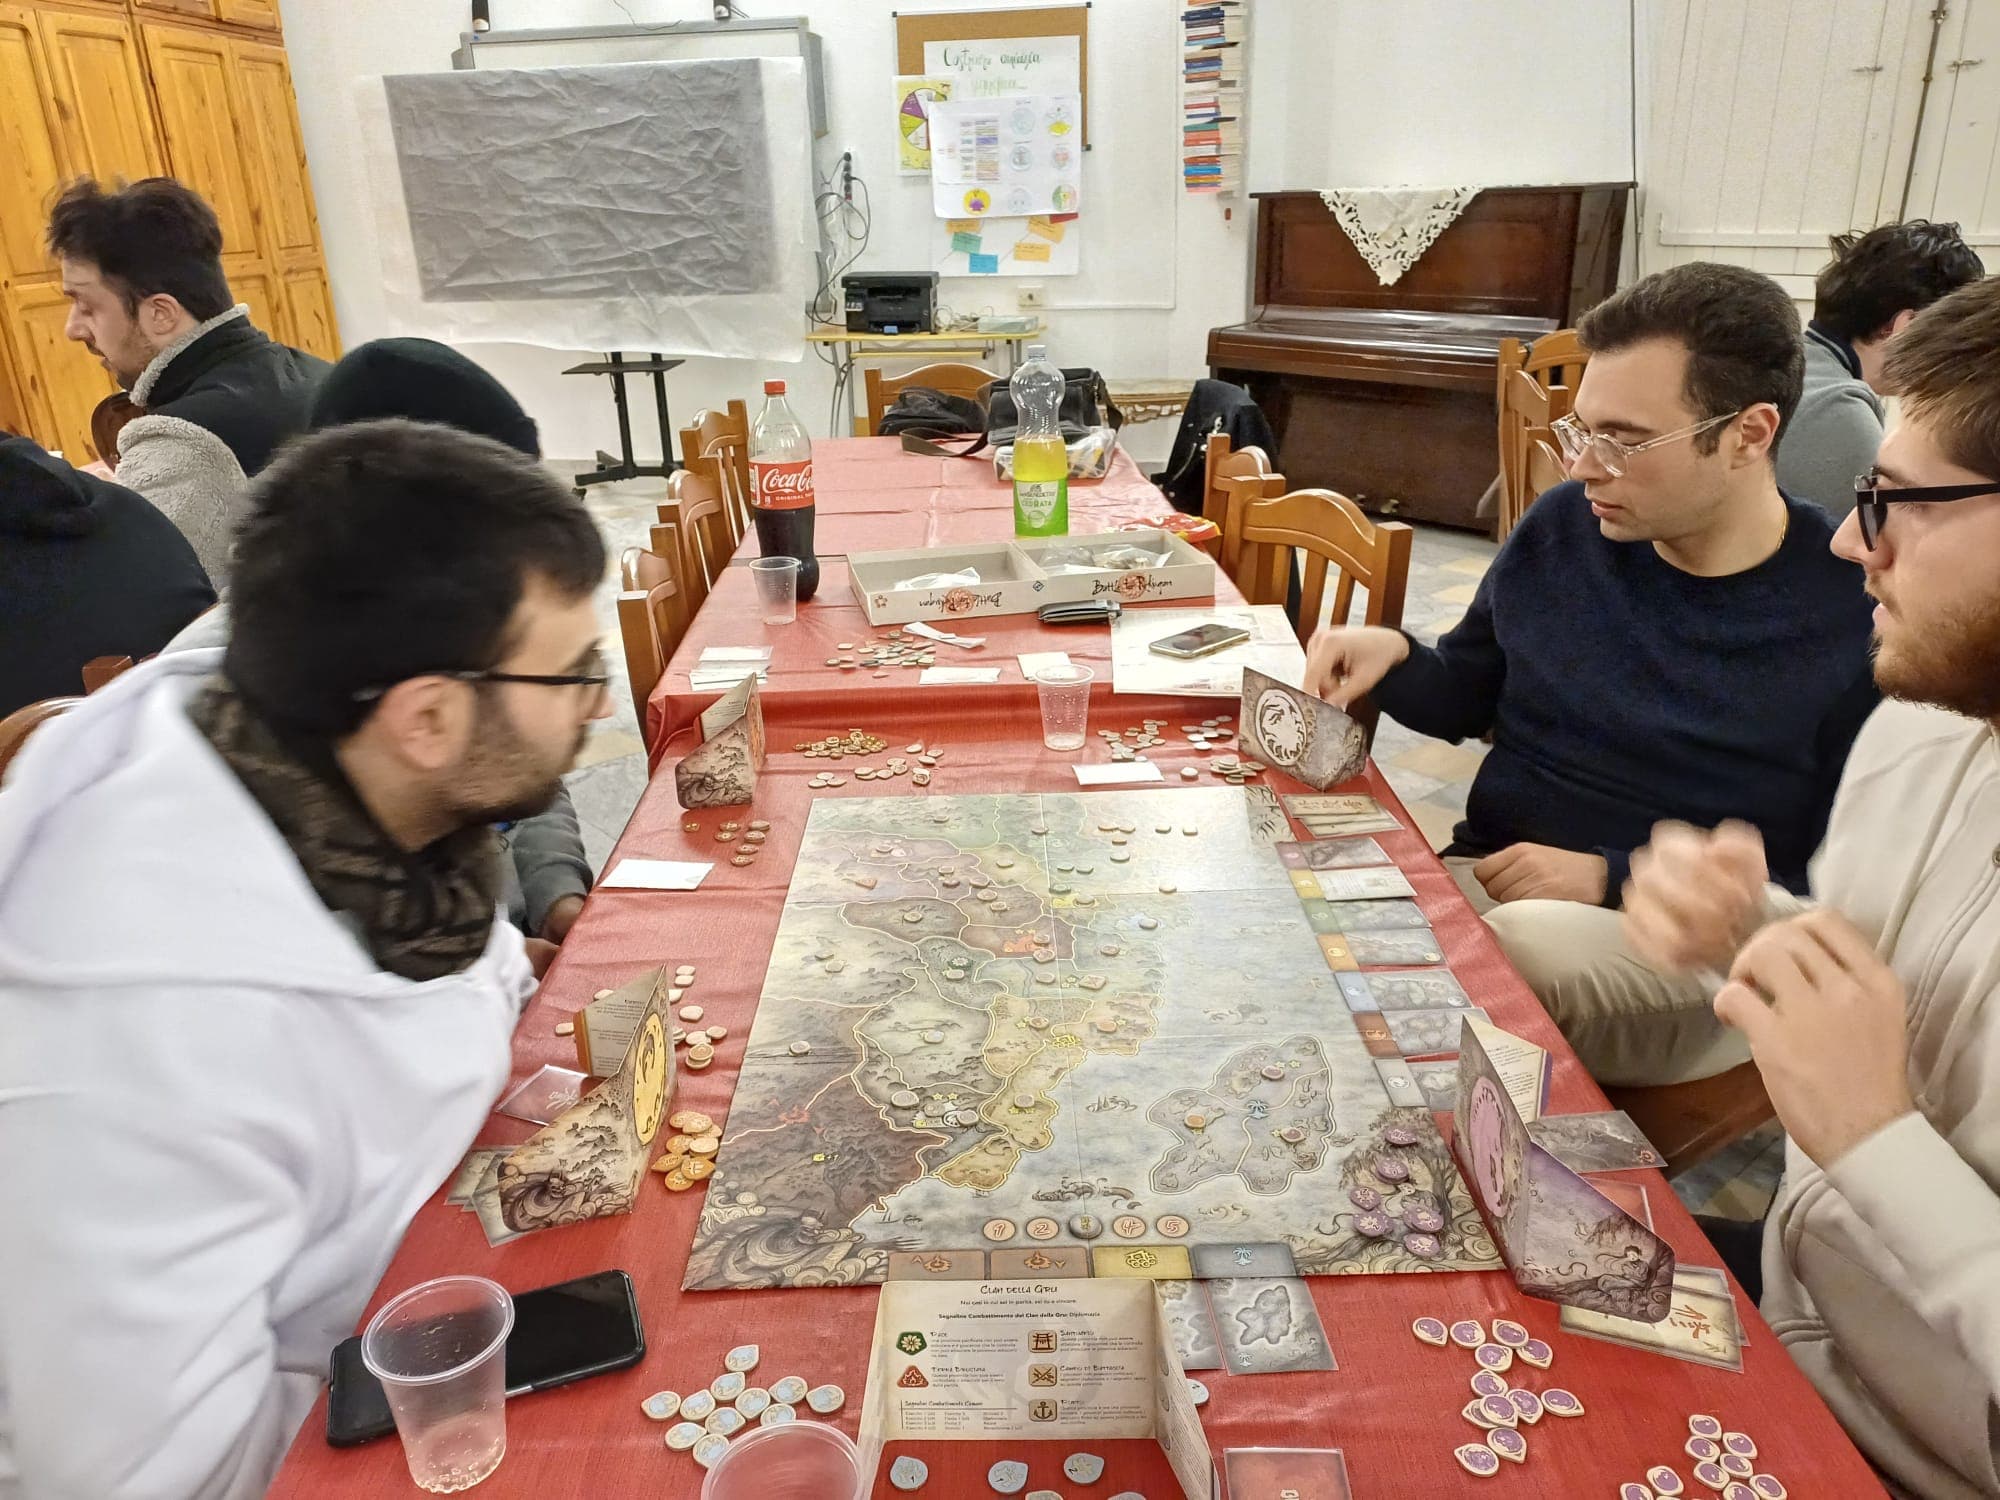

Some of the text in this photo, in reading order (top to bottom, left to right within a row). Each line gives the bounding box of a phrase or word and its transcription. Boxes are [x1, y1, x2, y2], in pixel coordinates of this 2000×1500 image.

[1092, 579, 1120, 596] Battle
[1034, 1223, 1051, 1236] 2
[1121, 1219, 1142, 1235] 4
[1165, 1219, 1180, 1233] 5
[1006, 1286, 1031, 1294] DELLA
[1034, 1284, 1058, 1293] GRU
